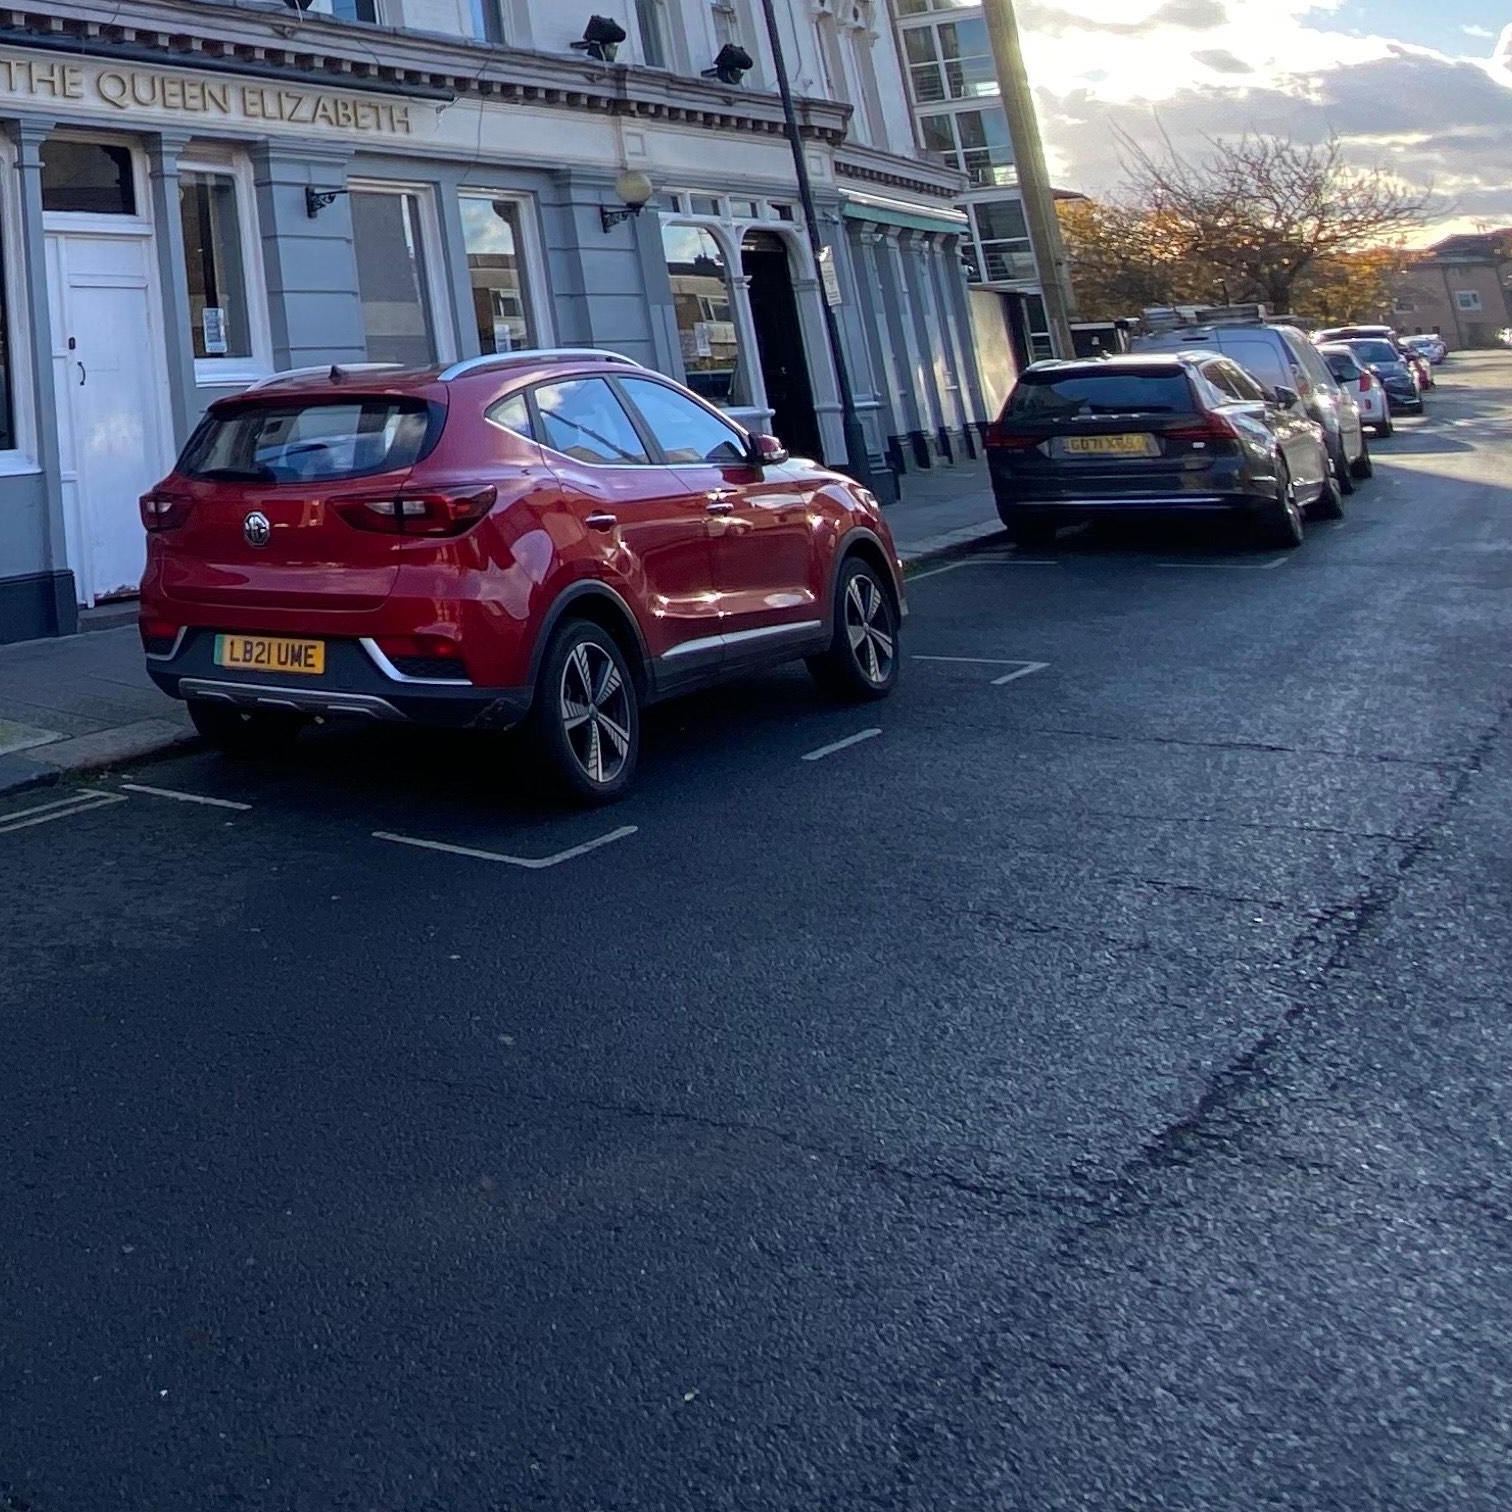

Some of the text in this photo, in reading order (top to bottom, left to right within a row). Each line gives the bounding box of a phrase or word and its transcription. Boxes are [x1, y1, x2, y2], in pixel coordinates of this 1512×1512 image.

[97, 71, 230, 114] QUEEN
[242, 87, 412, 134] ELIZABETH
[229, 640, 318, 667] LB21 UME
